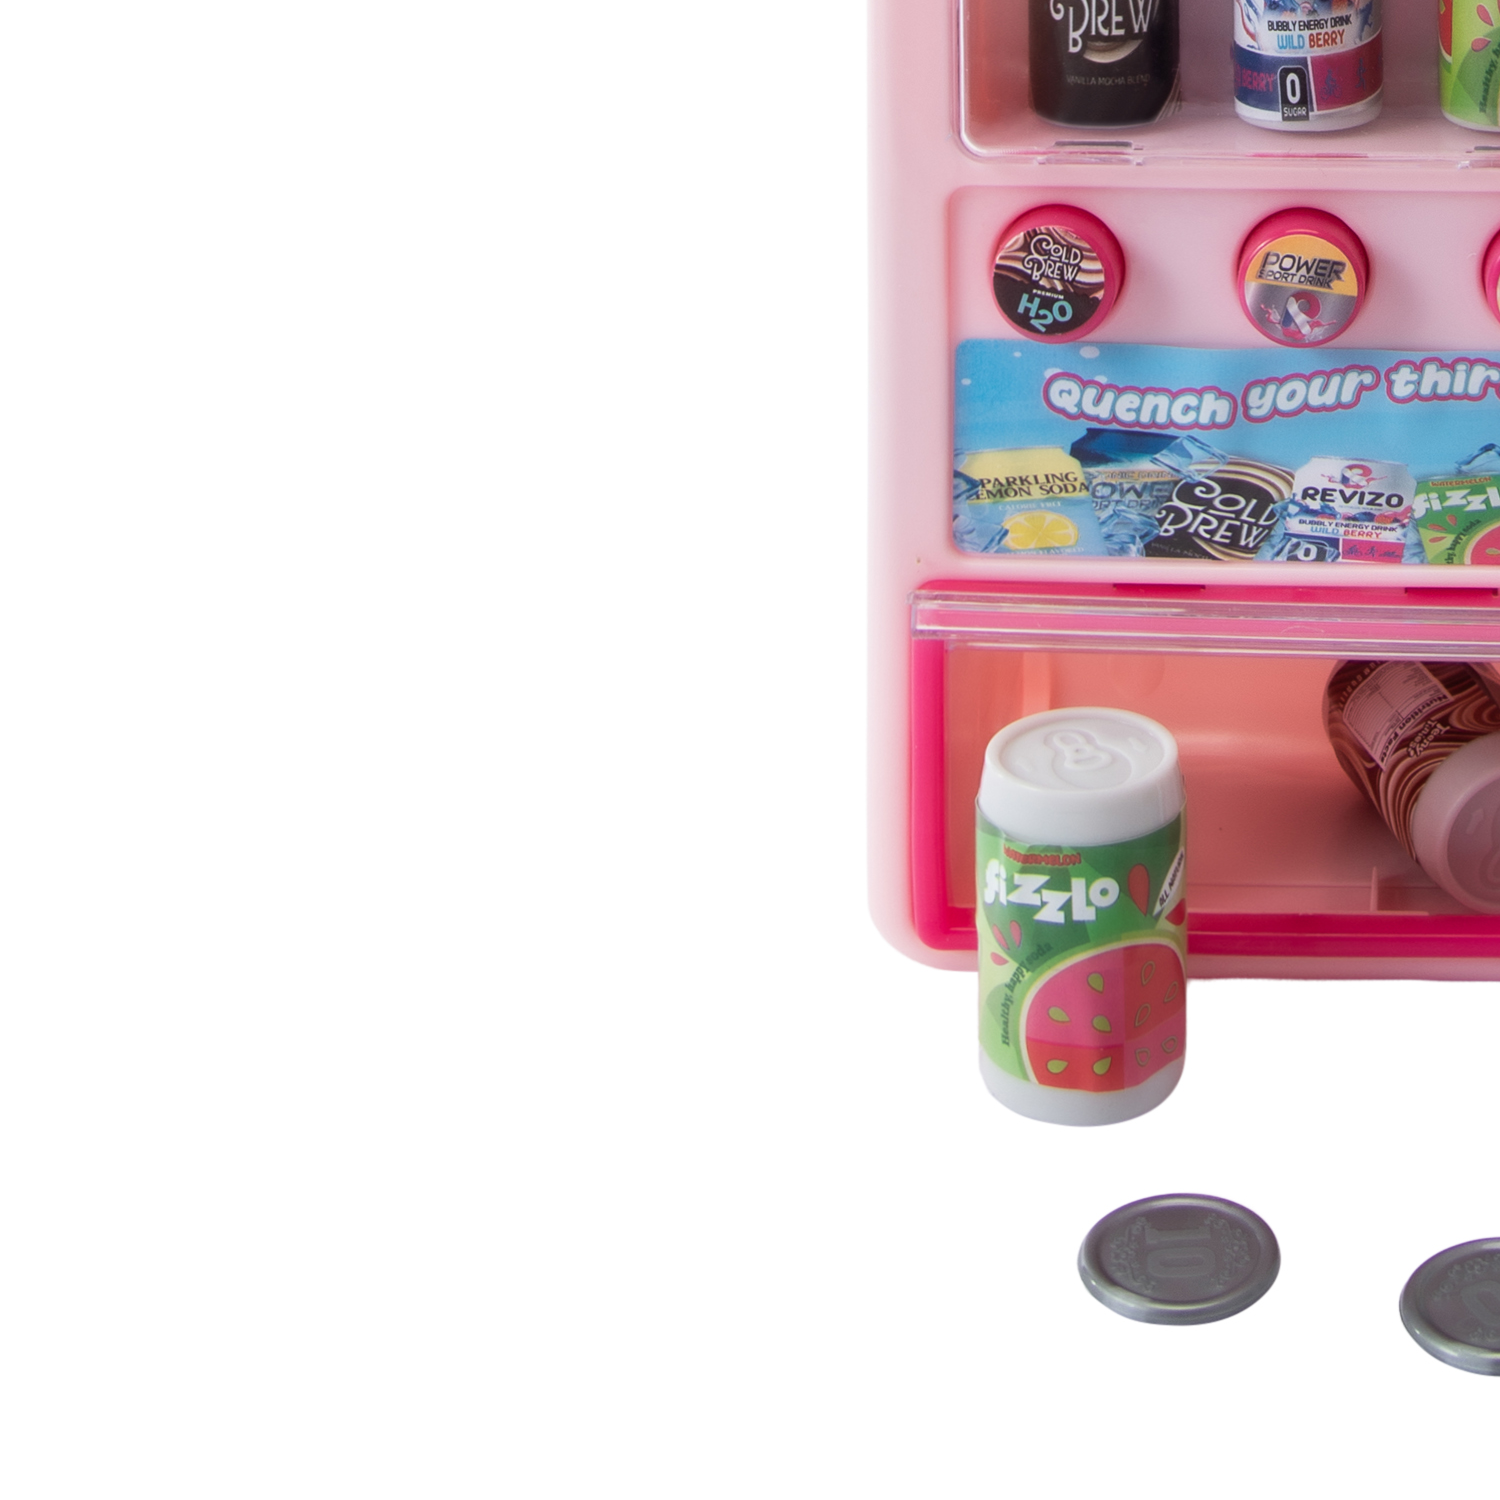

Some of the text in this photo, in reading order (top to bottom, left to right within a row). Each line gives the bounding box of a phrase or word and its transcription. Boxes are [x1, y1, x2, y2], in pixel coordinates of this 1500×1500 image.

[1267, 14, 1352, 31] BUBBLY ENERGY DRINK
[1277, 29, 1345, 49] WILD BERRY
[1286, 72, 1301, 104] 0
[1283, 107, 1307, 117] SUGAR
[1031, 234, 1081, 264] COLD
[1024, 255, 1078, 281] BREW
[1261, 252, 1347, 281] POWER
[1258, 268, 1334, 290] SPORT DRINK
[1032, 288, 1064, 299] PREMIUM
[1046, 375, 1233, 427] Quench
[1244, 367, 1378, 421] your
[969, 482, 1090, 501] EMON SODA
[979, 471, 1078, 489] PARKLING
[1091, 481, 1172, 499] OWE
[1430, 476, 1492, 487] WATERMELON
[1172, 478, 1279, 526] COLD
[1301, 486, 1404, 508] REVIZO
[1155, 502, 1269, 549] BREW
[1298, 518, 1398, 533] BUBBLY ENERGY DRINK
[1310, 526, 1382, 539] WILD BERRY
[1462, 519, 1482, 534] soda
[1398, 694, 1449, 731] Nutrition
[1379, 731, 1400, 763] Facts
[1415, 722, 1451, 758] Teeny
[1003, 843, 1082, 867] WATERMELON
[984, 858, 1120, 924] fizzlo
[1004, 960, 1031, 993] happy
[1025, 942, 1054, 965] soda
